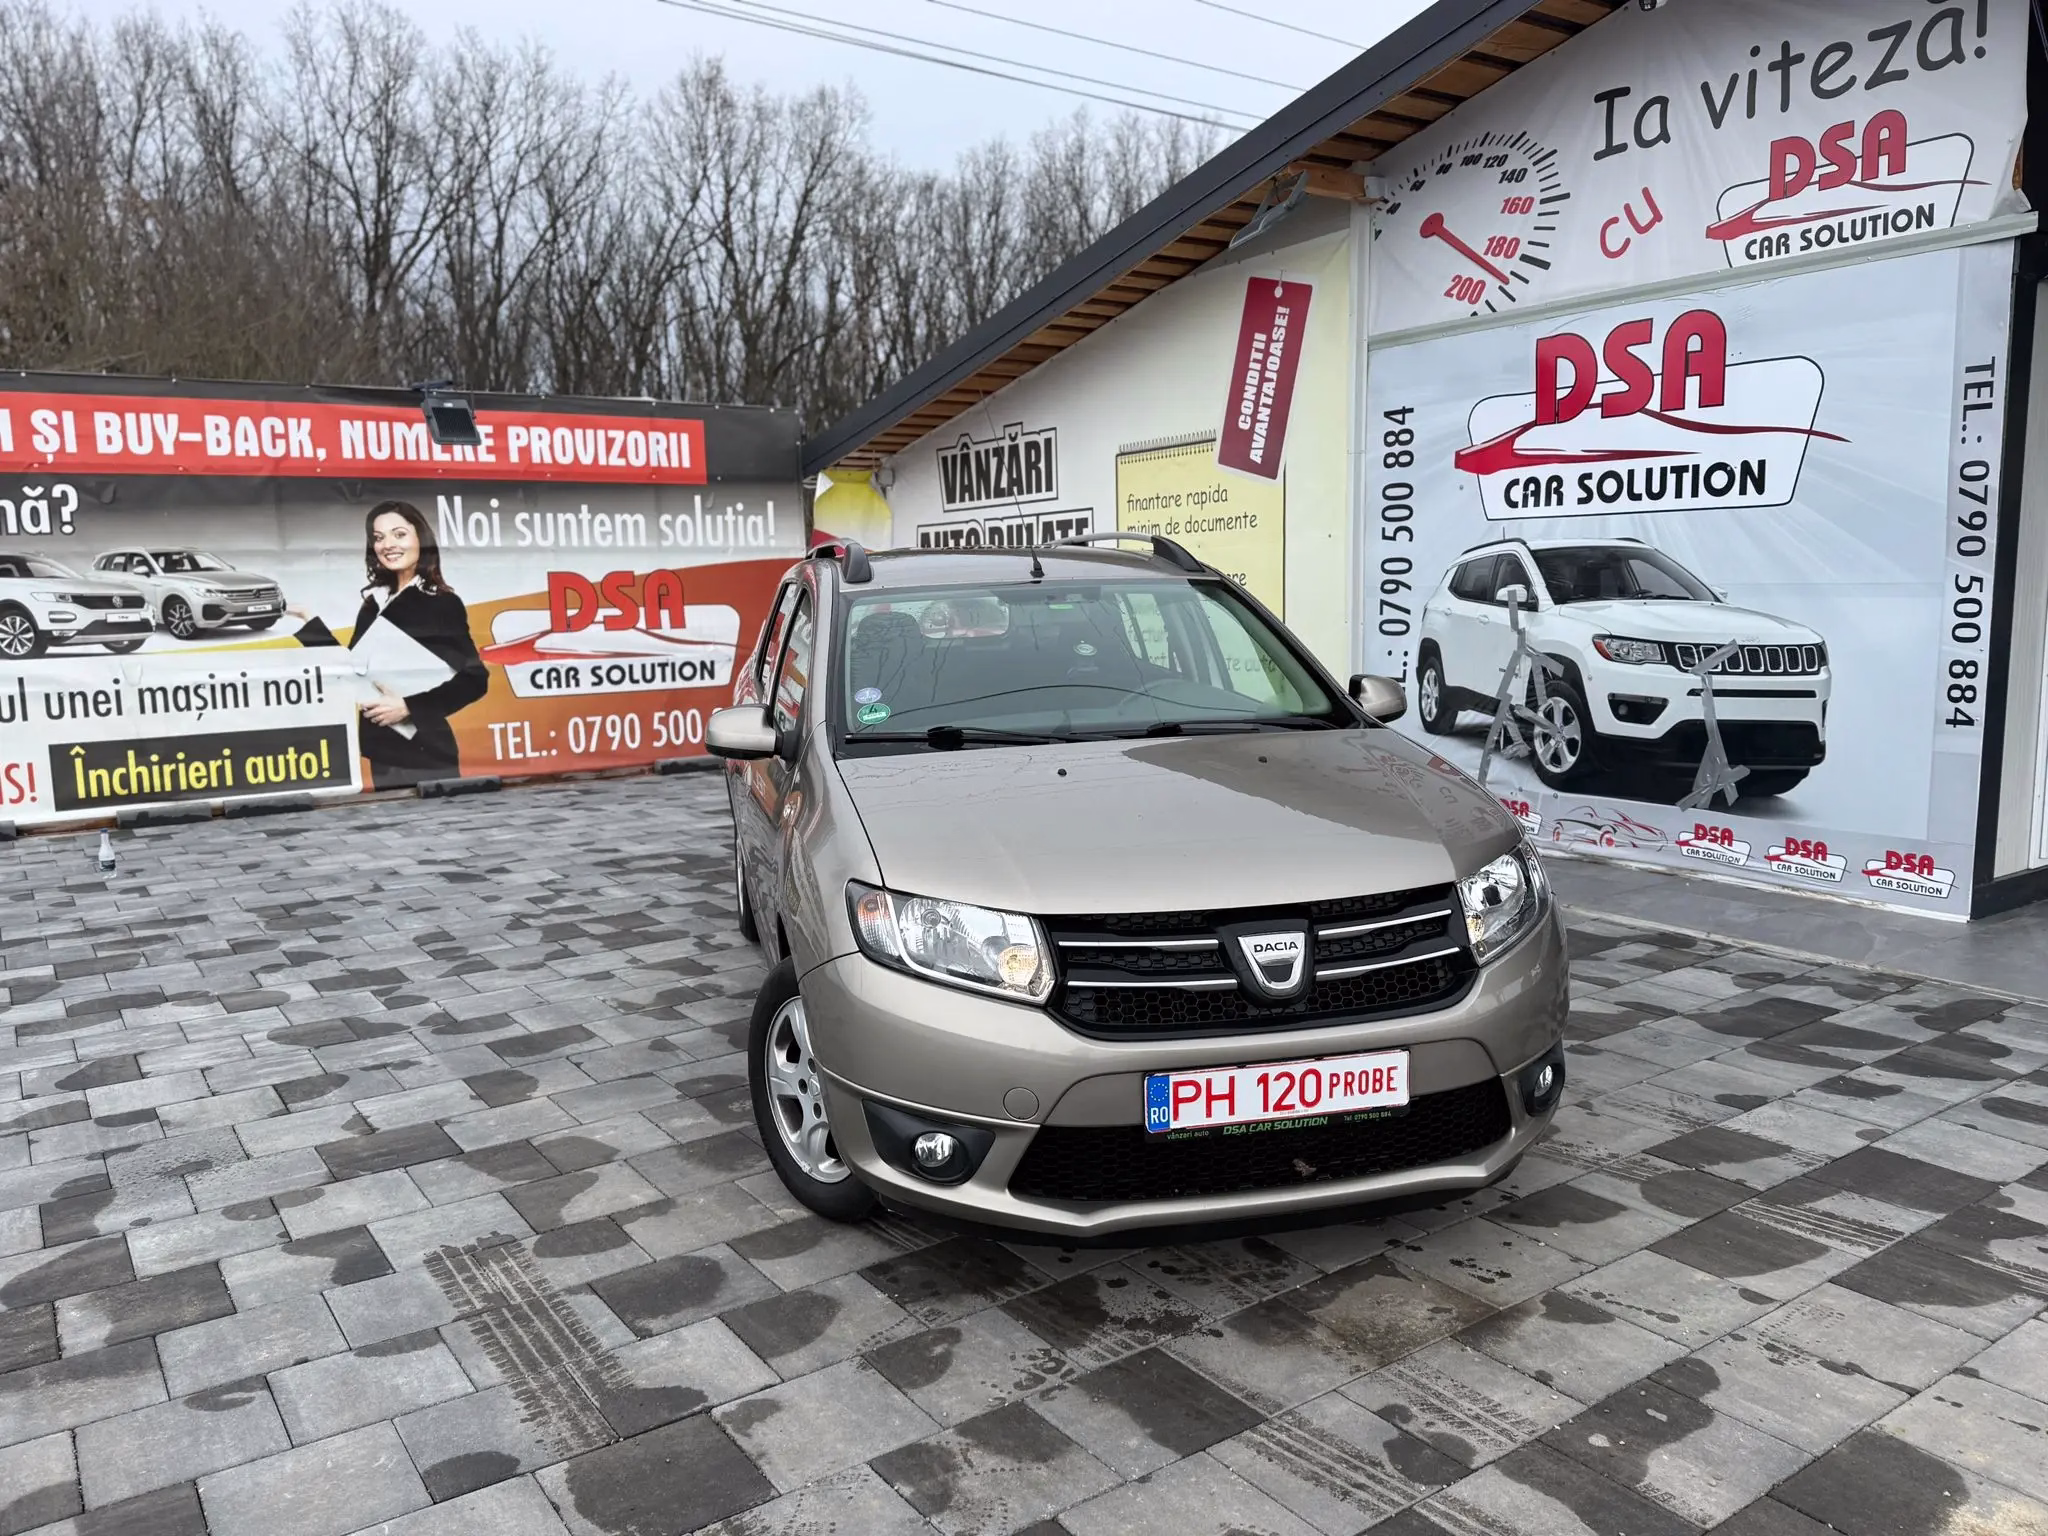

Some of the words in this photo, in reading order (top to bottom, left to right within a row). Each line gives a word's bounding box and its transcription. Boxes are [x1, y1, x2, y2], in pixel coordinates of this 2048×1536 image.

[1594, 85, 1671, 162] Ia
[1700, 0, 1988, 130] viteză!
[1460, 153, 1483, 167] 100
[1483, 154, 1509, 169] 120
[1499, 168, 1528, 184] 140
[1768, 108, 1908, 202] DSA
[1500, 197, 1535, 215] 160
[1600, 186, 1663, 259] cu
[1744, 238, 1791, 261] CAR
[1799, 203, 1936, 253] SOLUTION
[1484, 236, 1521, 259] 180
[1443, 275, 1487, 305] 200
[1238, 332, 1267, 431] CONDITII
[1249, 305, 1290, 465] AVANTAJOASE!
[1535, 310, 1727, 426] DSA
[1960, 355, 1997, 446] TEL.:
[30, 408, 77, 464] ȘI
[506, 424, 692, 470] PROVIZORII
[1382, 405, 1416, 470] 884
[941, 432, 1054, 505] VÂNZĂRI
[1503, 476, 1565, 509] CAR
[1577, 459, 1767, 505] SOLUTION
[435, 494, 501, 548] Noi
[513, 504, 647, 549] suntem
[1126, 491, 1182, 513] finantare
[1186, 483, 1228, 511] rapida
[1127, 519, 1161, 537] minim
[1164, 516, 1181, 535] de
[1184, 511, 1258, 534] documente
[1381, 481, 1415, 543] 500
[1956, 459, 1991, 558] 0790
[547, 569, 686, 633] DSA
[1378, 557, 1413, 637] 0790
[1951, 573, 1985, 644] 500
[44, 678, 121, 720] unei
[138, 671, 249, 721] mașini
[264, 666, 324, 706] noi!
[529, 667, 580, 690] CAR
[590, 659, 716, 688] SOLUTION
[1944, 658, 1980, 729] 884
[488, 721, 558, 760] TEL.:
[568, 712, 641, 754] 0790
[652, 708, 703, 747] 500
[69, 744, 234, 799] Închirieri
[245, 738, 331, 782] auto!
[1686, 848, 1701, 857] CAR
[1701, 851, 1741, 864] SOLUTION
[1694, 823, 1733, 847] DSA
[1785, 836, 1828, 861] DSA
[1777, 863, 1793, 873] CAR
[1794, 865, 1837, 880] SOLUTION
[1876, 878, 1894, 889] CAR
[1895, 880, 1943, 897] SOLUTION
[1885, 850, 1935, 876] DSA
[1253, 941, 1299, 953] DACIA
[1150, 1106, 1168, 1125] RO
[1172, 1076, 1236, 1122] PH
[1256, 1068, 1322, 1114] 120
[1328, 1066, 1398, 1099] PROBE
[1222, 1125, 1247, 1136] DSA
[1249, 1122, 1272, 1132] CAR
[1273, 1117, 1329, 1131] SOLUTION
